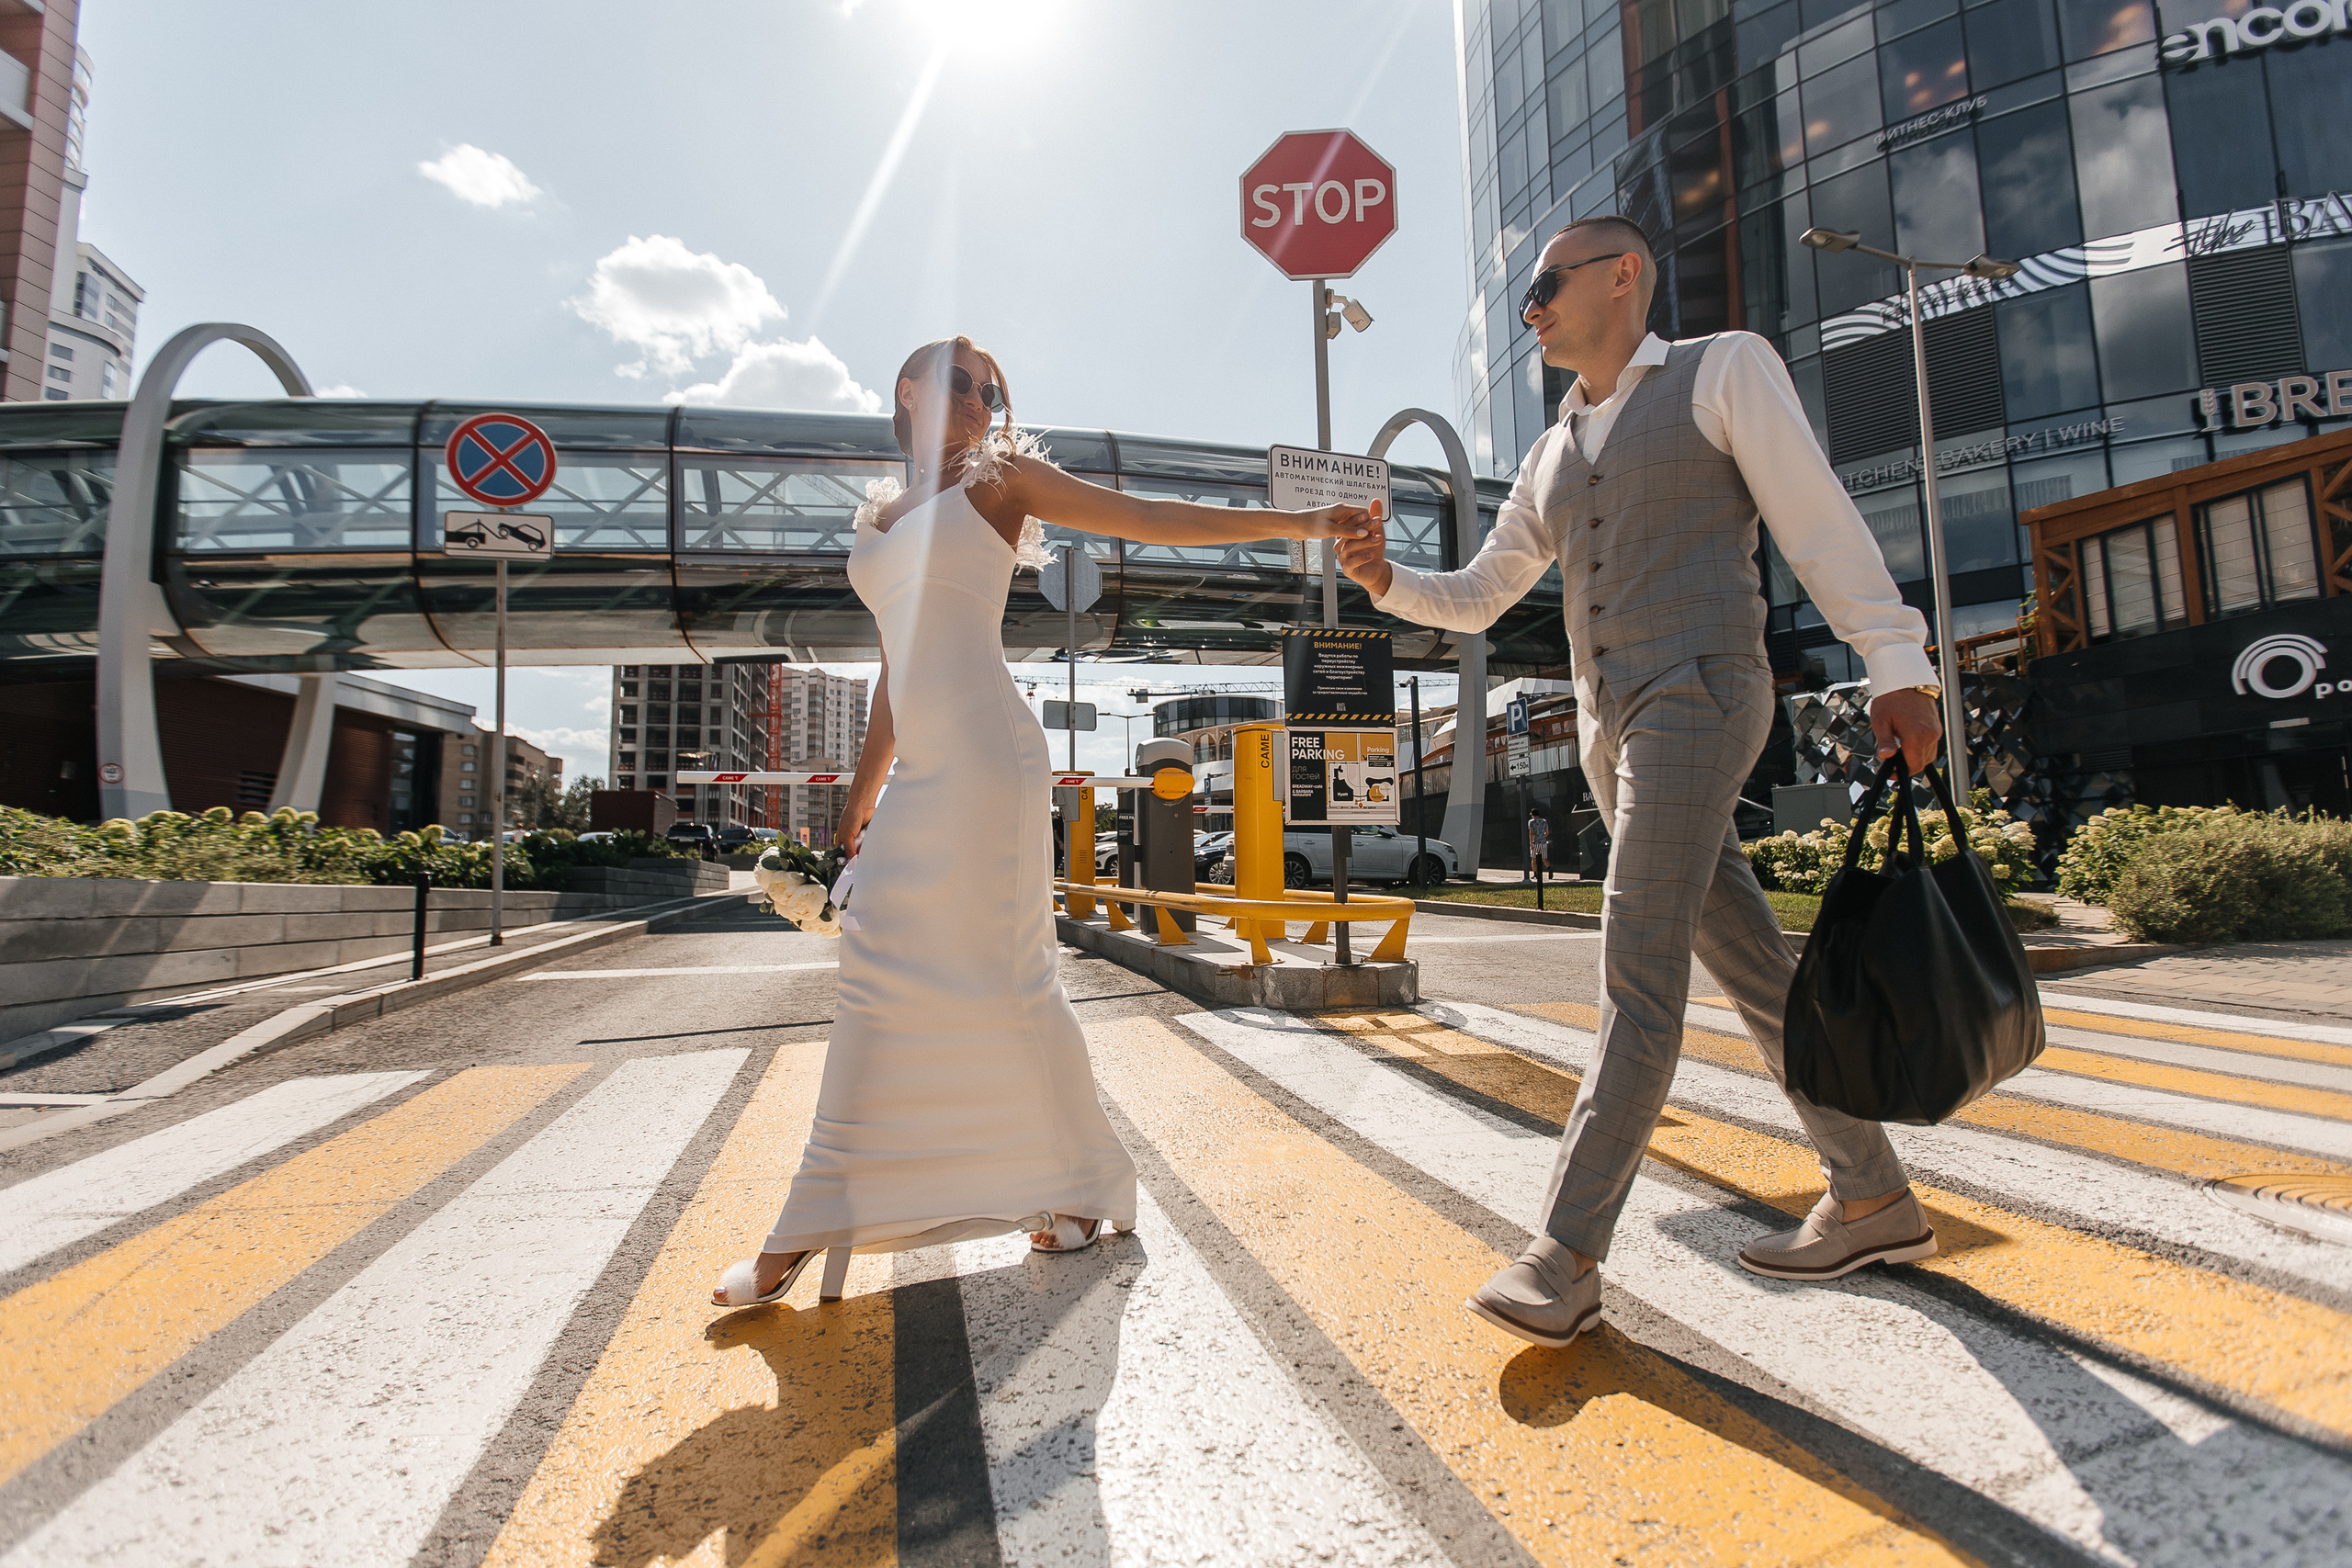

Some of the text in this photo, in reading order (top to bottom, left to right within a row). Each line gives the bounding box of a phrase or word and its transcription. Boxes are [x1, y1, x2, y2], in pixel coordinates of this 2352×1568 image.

[1874, 95, 1987, 144] ФИТНЕС-КЛУБ
[1251, 178, 1386, 228] STOP
[1838, 416, 2126, 487] ITCHEN BAKERY WINE
[1280, 453, 1380, 479] ВНИМАНИЕ!
[1274, 471, 1387, 491] АВТОМАТИЧЕСКИЙ ШЛАГБАУМ
[1295, 486, 1324, 496] ПРОЕЗД
[1338, 492, 1368, 501] ОДНОМУ
[1314, 641, 1363, 649] ВНИМАНИЕ!
[1510, 704, 1522, 731] P
[1261, 734, 1270, 769] CAME
[1292, 737, 1320, 748] FREE
[1292, 749, 1345, 761] PARKING
